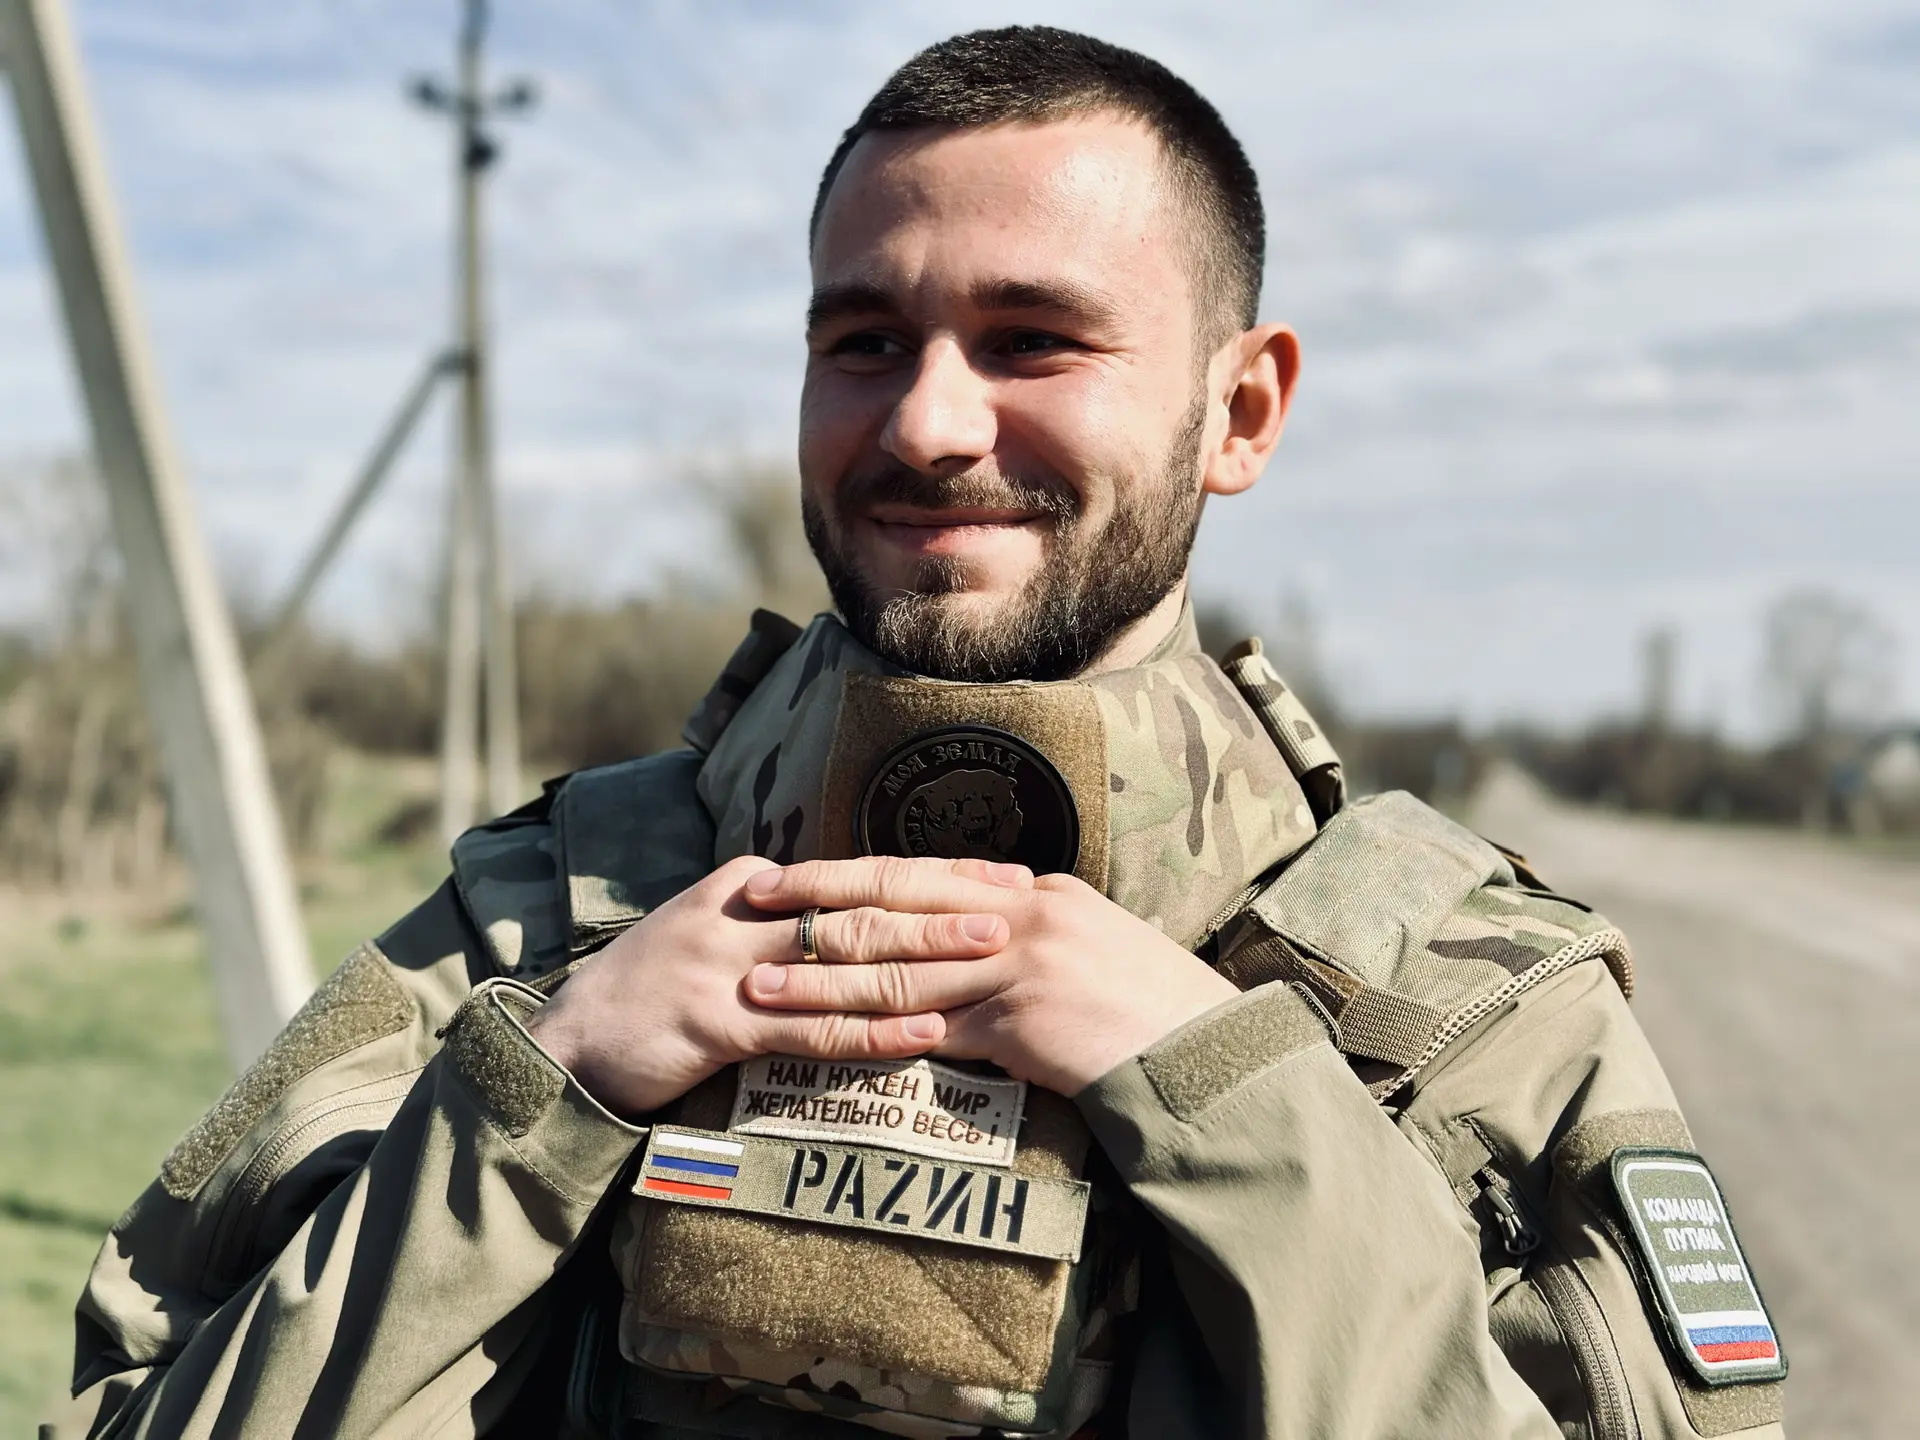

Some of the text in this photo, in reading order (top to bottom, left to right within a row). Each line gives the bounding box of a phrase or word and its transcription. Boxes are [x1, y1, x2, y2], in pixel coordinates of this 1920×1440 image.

[881, 742, 1022, 797] МОЯ ЗЕМЛЯ
[766, 1061, 819, 1089] НАМ
[825, 1065, 921, 1101] НУЖЕН
[744, 1089, 999, 1146] ЖЕЛАТЕЛЬНО ВЕСЬ!
[1643, 1197, 1721, 1226] КОМАНДА
[1663, 1227, 1726, 1252] ПУТИНА
